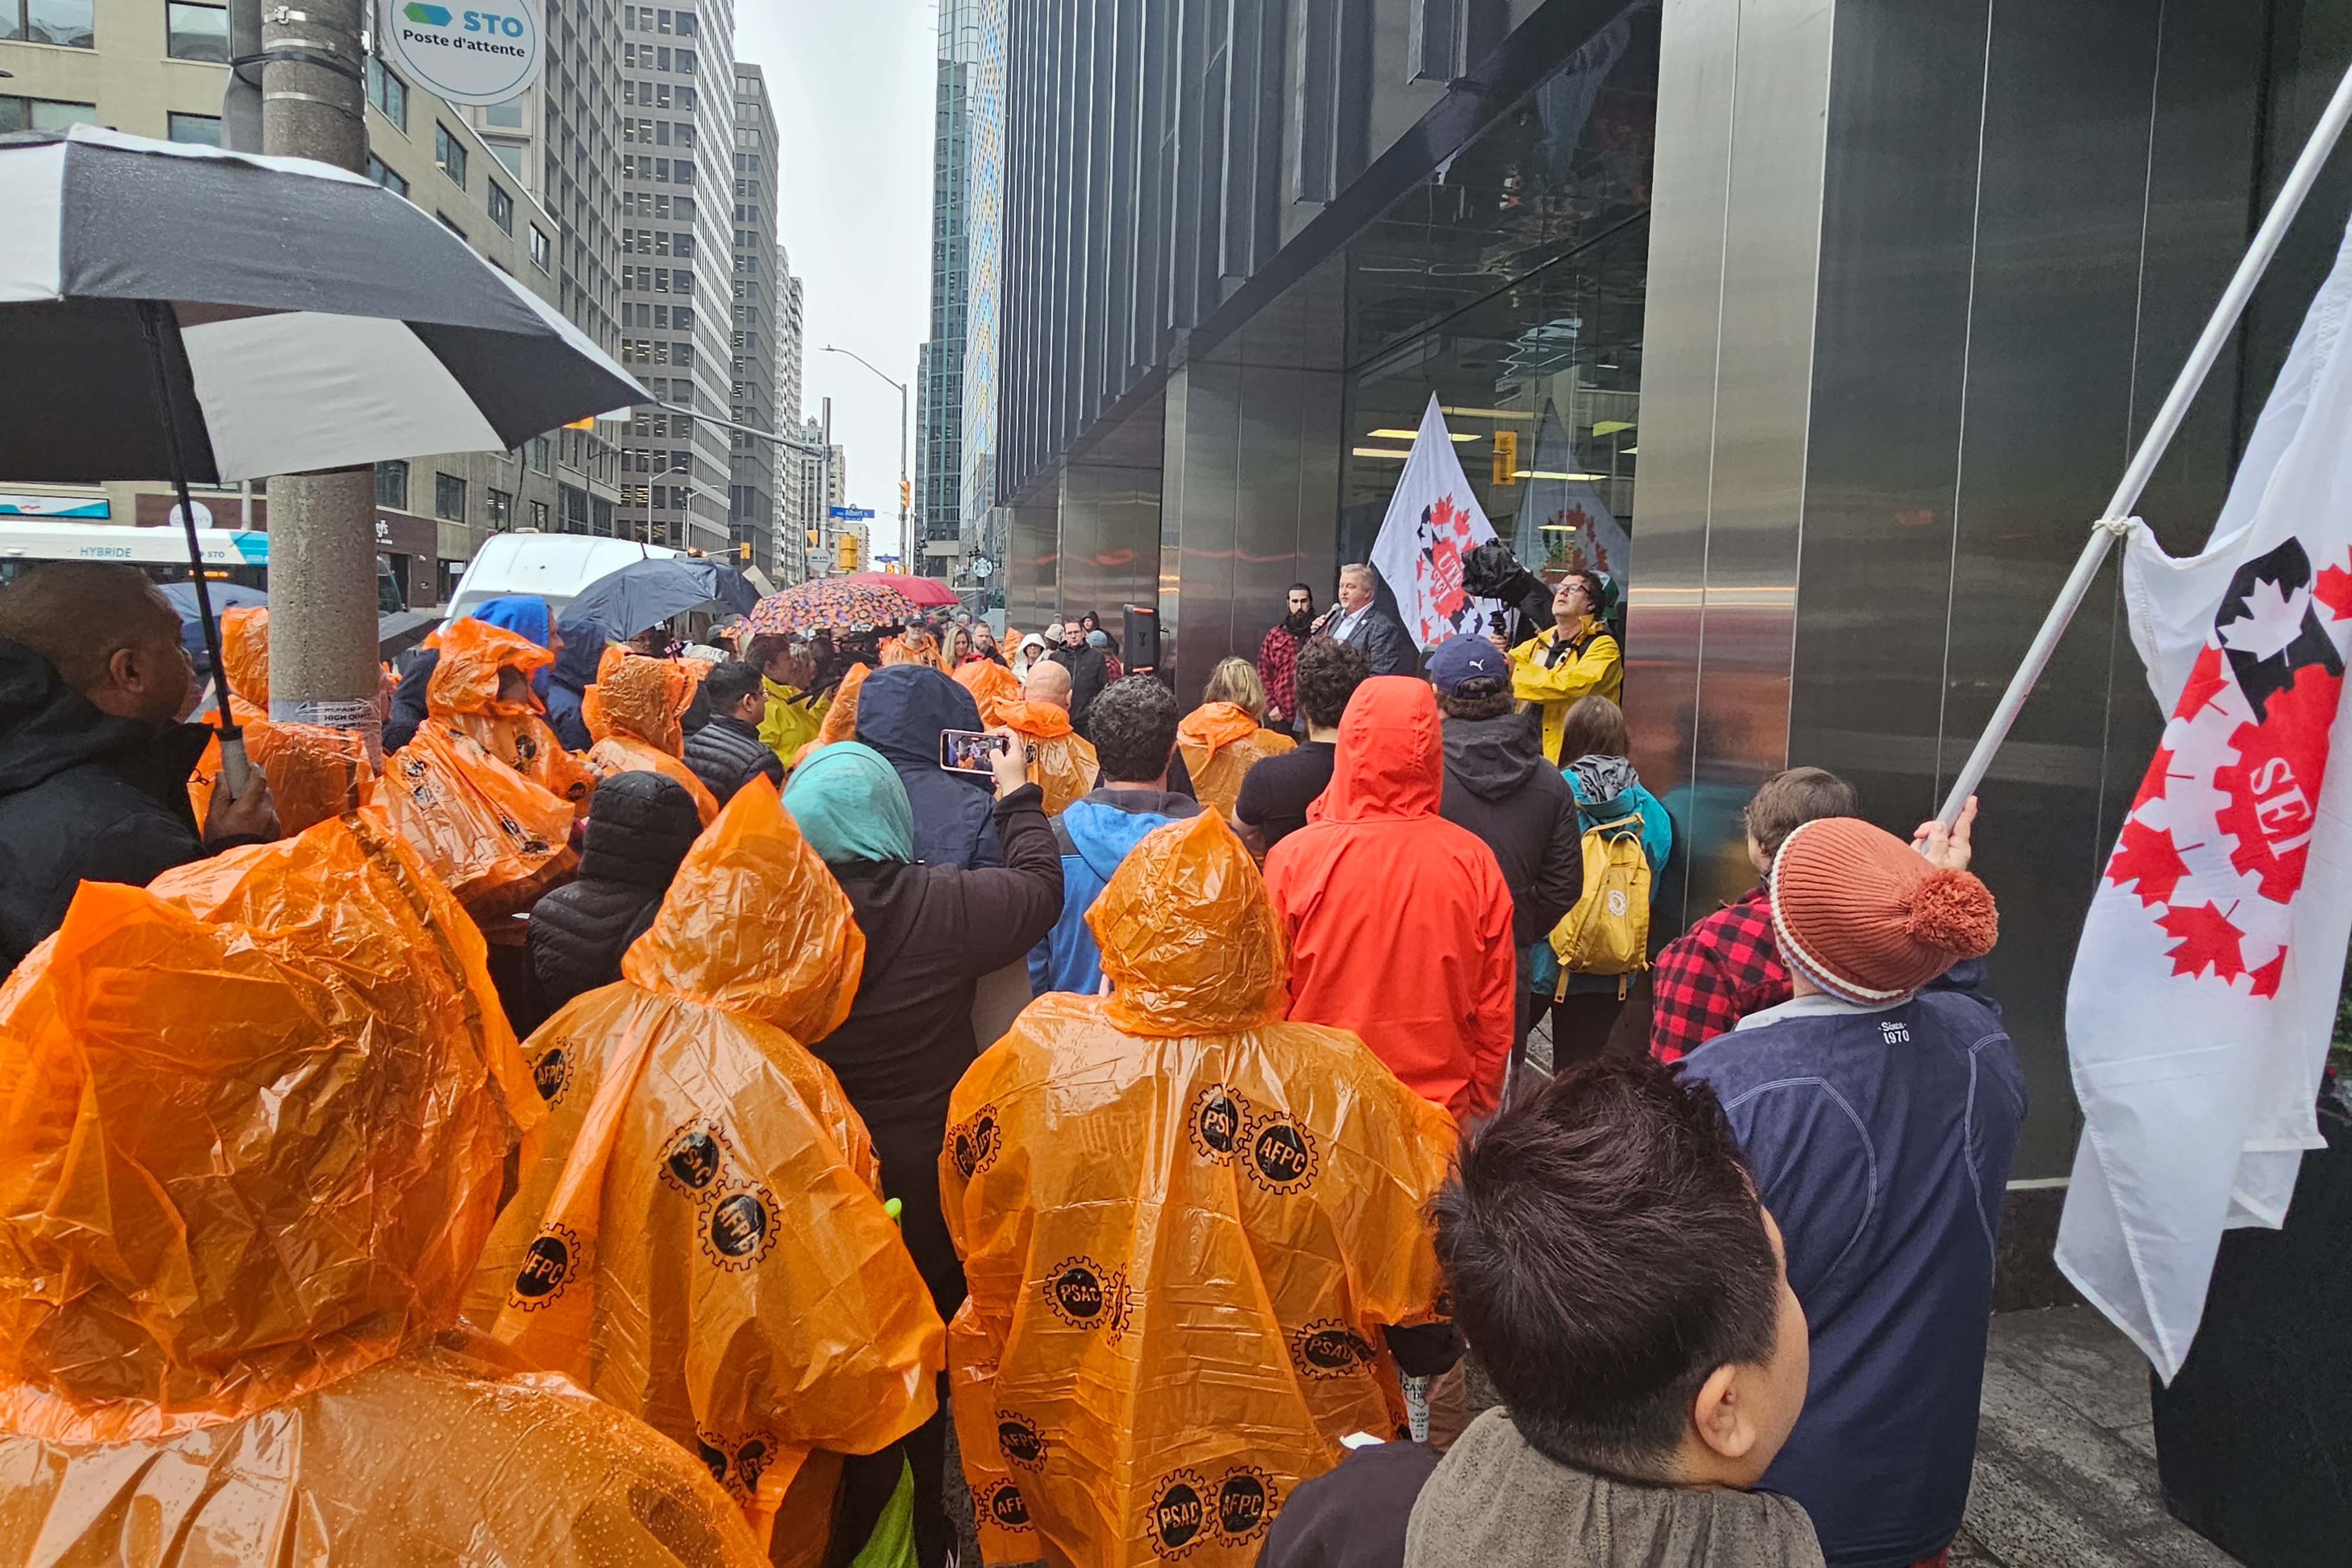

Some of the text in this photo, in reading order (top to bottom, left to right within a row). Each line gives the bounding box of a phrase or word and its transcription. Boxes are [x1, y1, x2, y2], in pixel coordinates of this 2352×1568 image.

[463, 11, 523, 38] STO
[403, 29, 524, 57] Poste d'attente
[81, 547, 132, 558] HYBRIDE
[2249, 757, 2312, 861] SEI
[1883, 1029, 1910, 1044] 1970
[1258, 1136, 1305, 1173] AFPC
[1061, 1284, 1100, 1302] PSAC
[1002, 1433, 1039, 1449] AFPC
[1161, 1502, 1198, 1529] PSAC
[1222, 1493, 1261, 1516] AFPC
